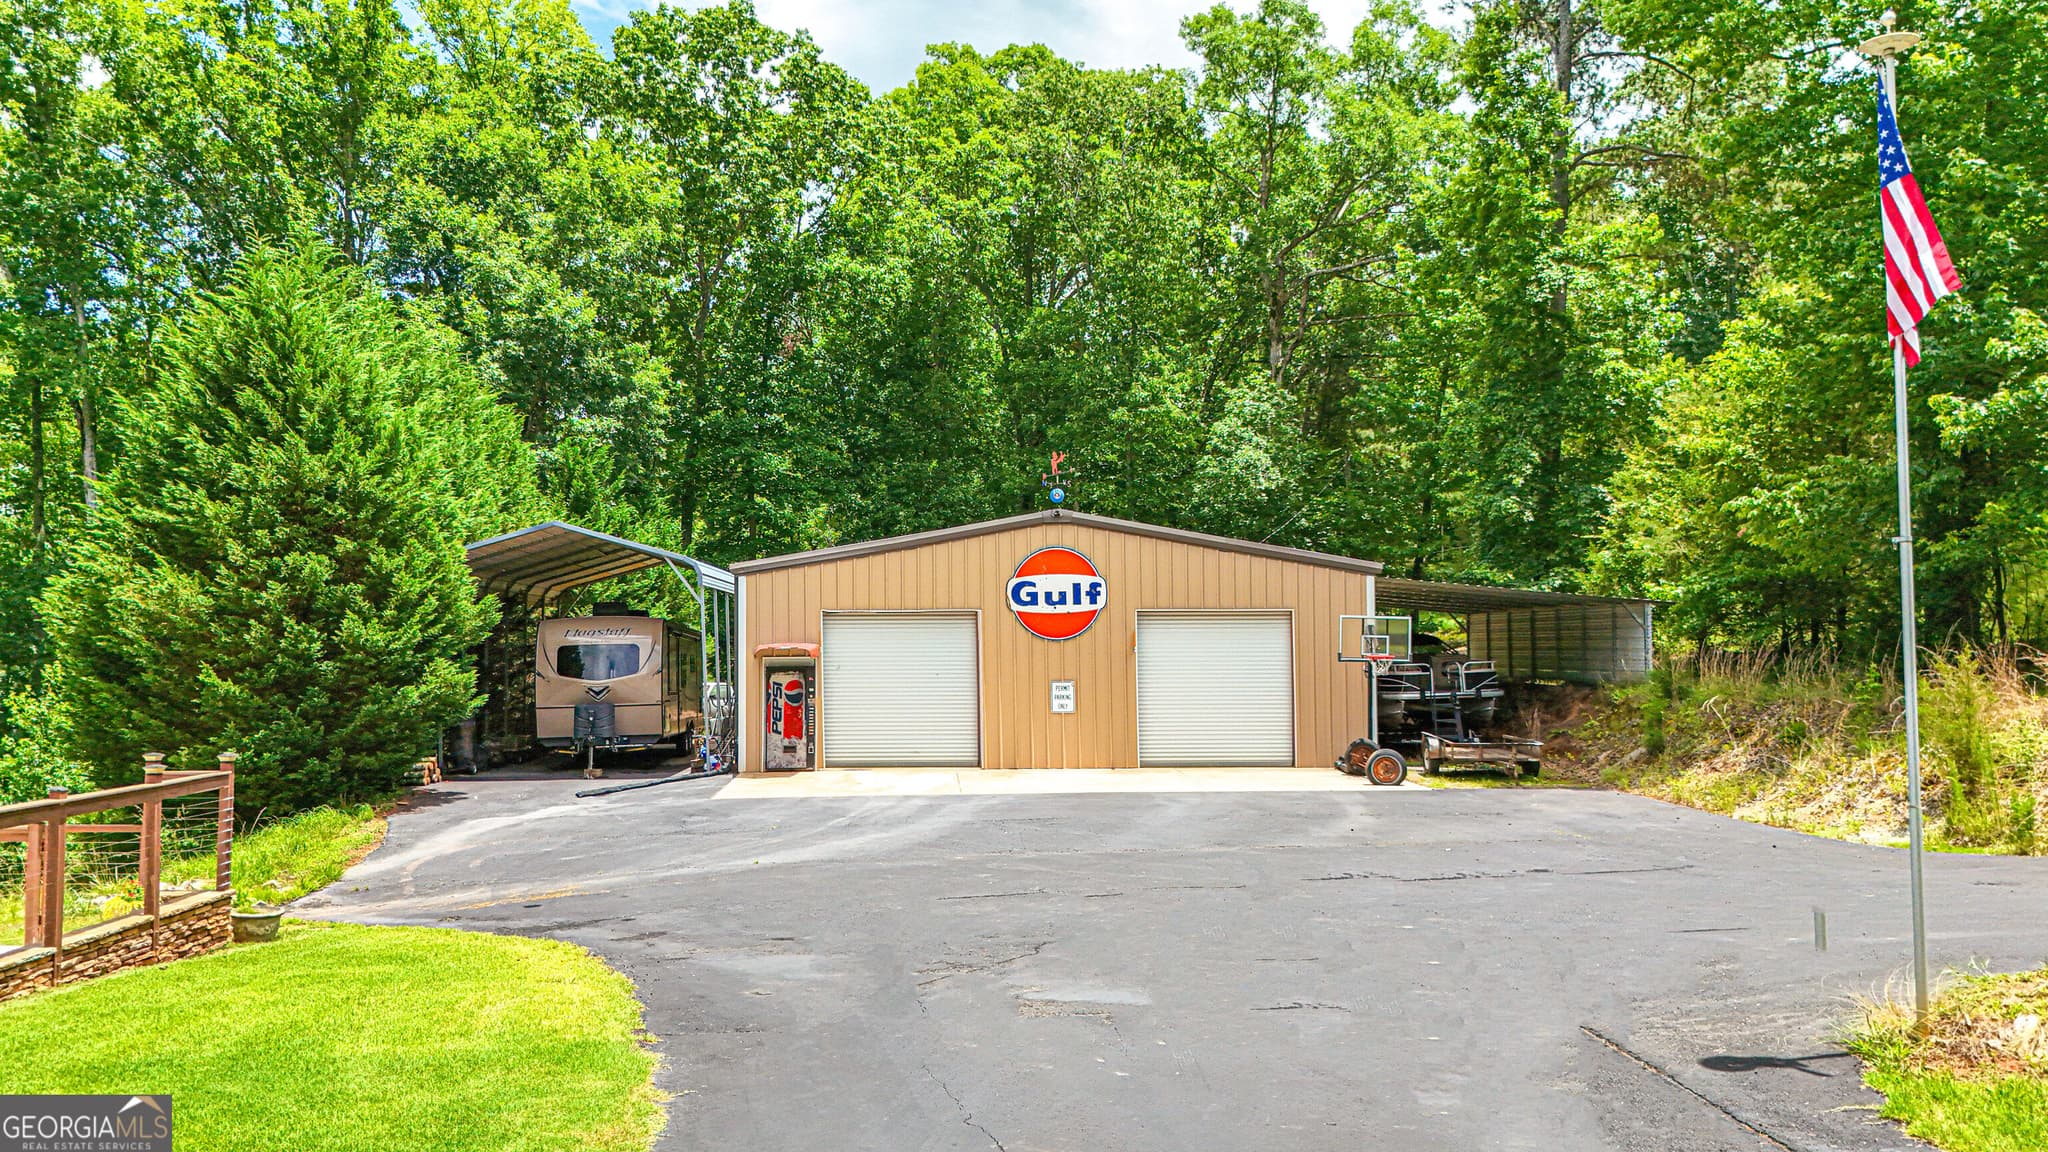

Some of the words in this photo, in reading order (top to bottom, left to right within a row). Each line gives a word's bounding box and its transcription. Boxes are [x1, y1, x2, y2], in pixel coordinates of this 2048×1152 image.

[1011, 581, 1102, 606] Gulf
[564, 626, 632, 638] Flagstaff
[772, 681, 783, 735] PEPSI
